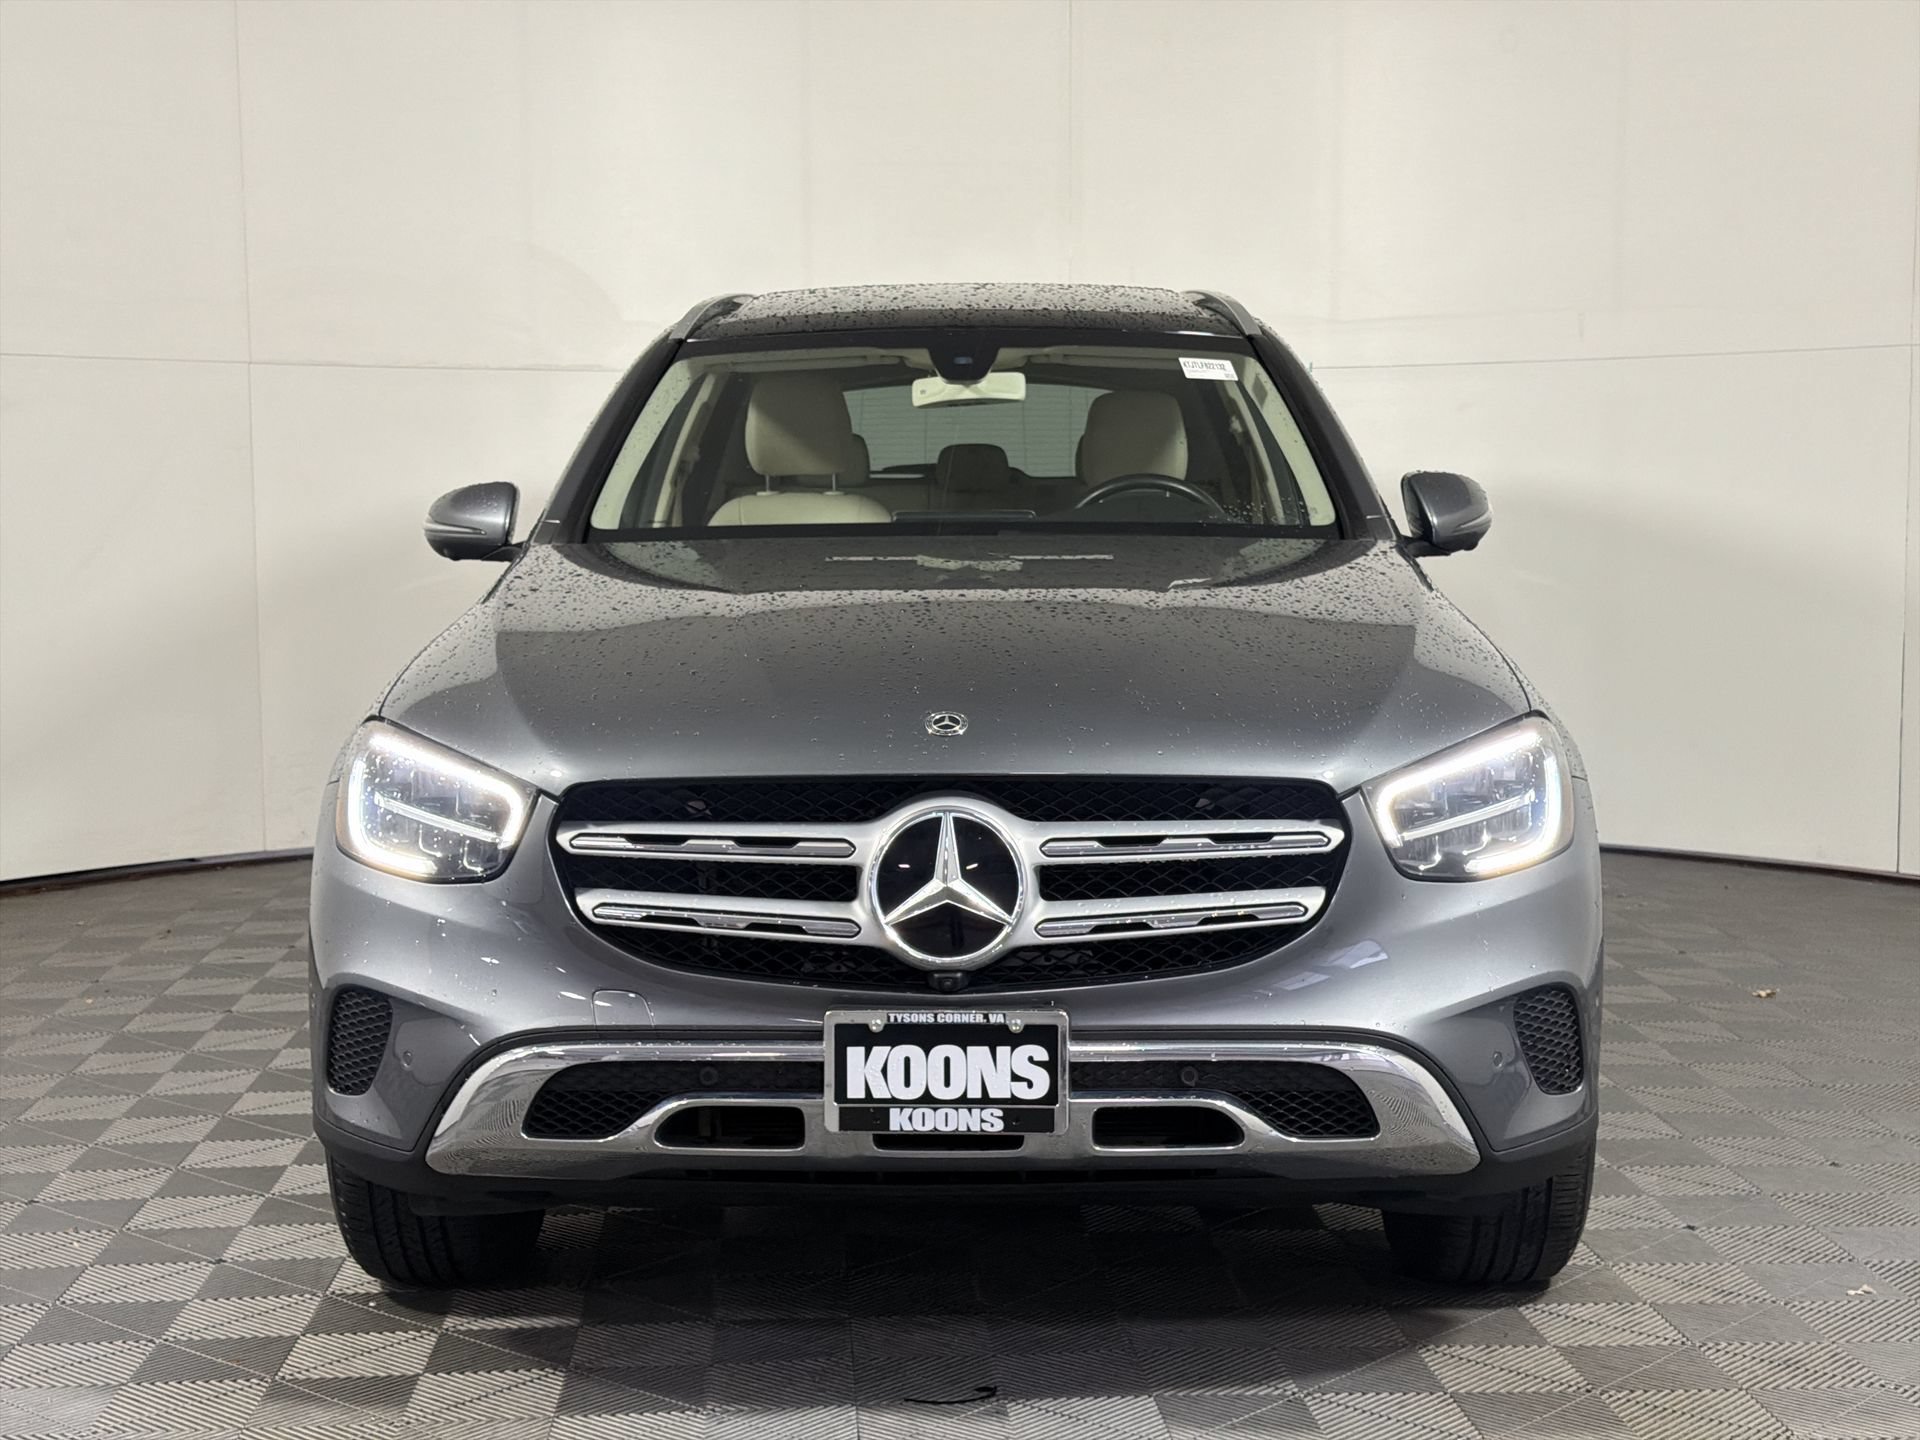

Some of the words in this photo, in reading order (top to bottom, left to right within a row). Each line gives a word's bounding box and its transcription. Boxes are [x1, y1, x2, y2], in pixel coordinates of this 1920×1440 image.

[888, 1013, 935, 1024] TYSONS
[989, 1013, 1005, 1024] VA
[846, 1044, 1050, 1100] KOONS
[889, 1107, 1004, 1132] KOONS
